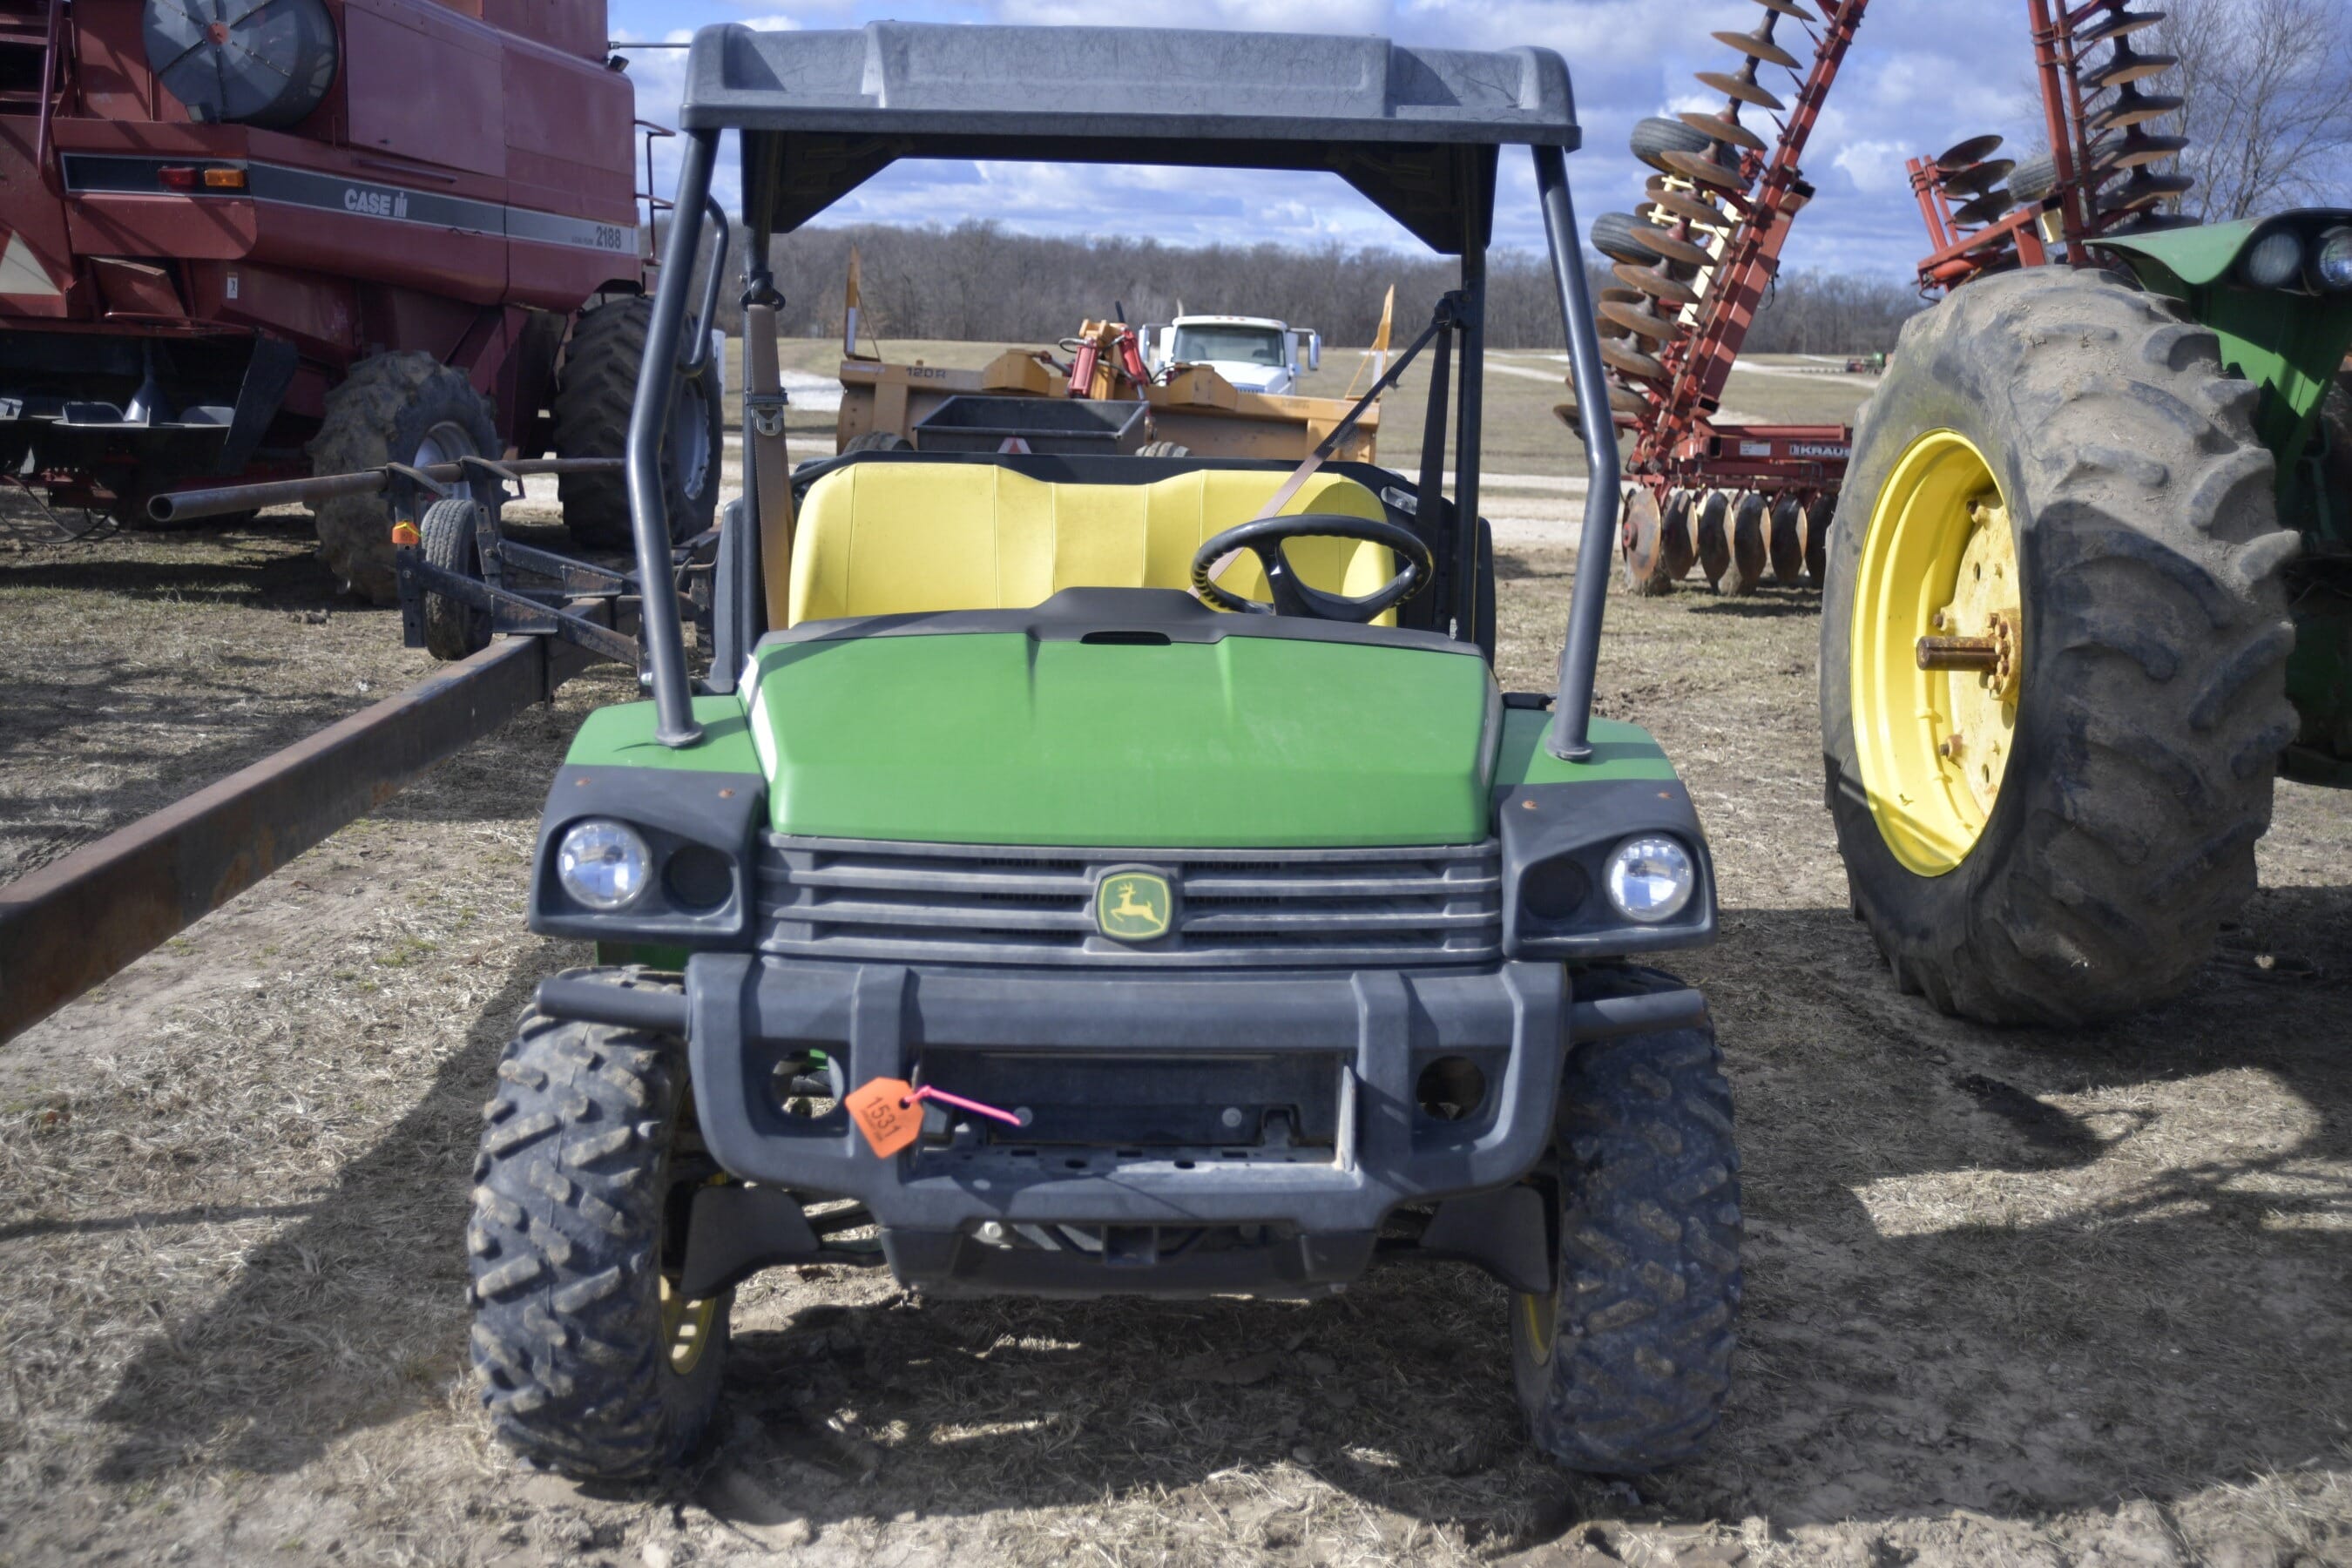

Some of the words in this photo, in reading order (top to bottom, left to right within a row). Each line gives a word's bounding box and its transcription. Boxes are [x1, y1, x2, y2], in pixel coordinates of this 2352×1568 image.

[344, 188, 391, 215] CASE
[596, 226, 621, 249] 2188
[866, 1096, 902, 1139] 1531
